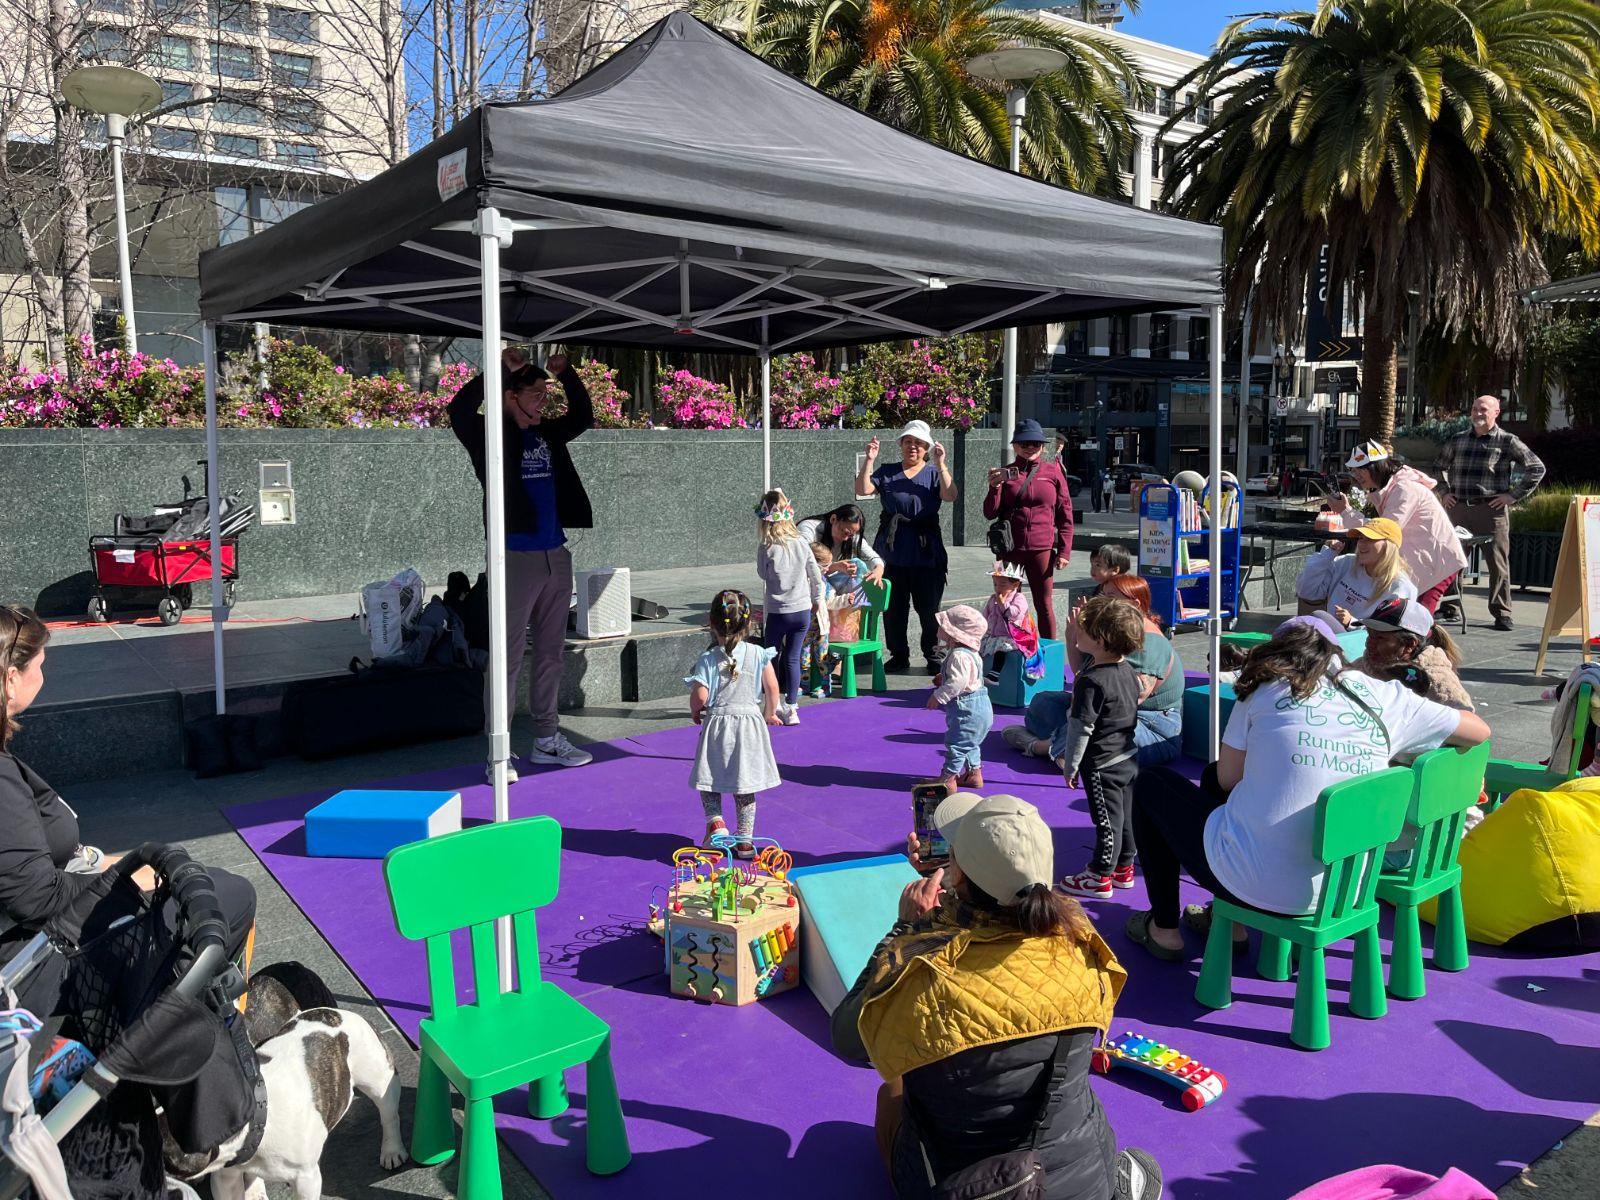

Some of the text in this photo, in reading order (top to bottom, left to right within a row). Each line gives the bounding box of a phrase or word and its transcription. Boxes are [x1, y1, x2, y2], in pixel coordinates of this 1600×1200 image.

[1298, 731, 1373, 760] Running
[1291, 752, 1373, 776] on Modal
